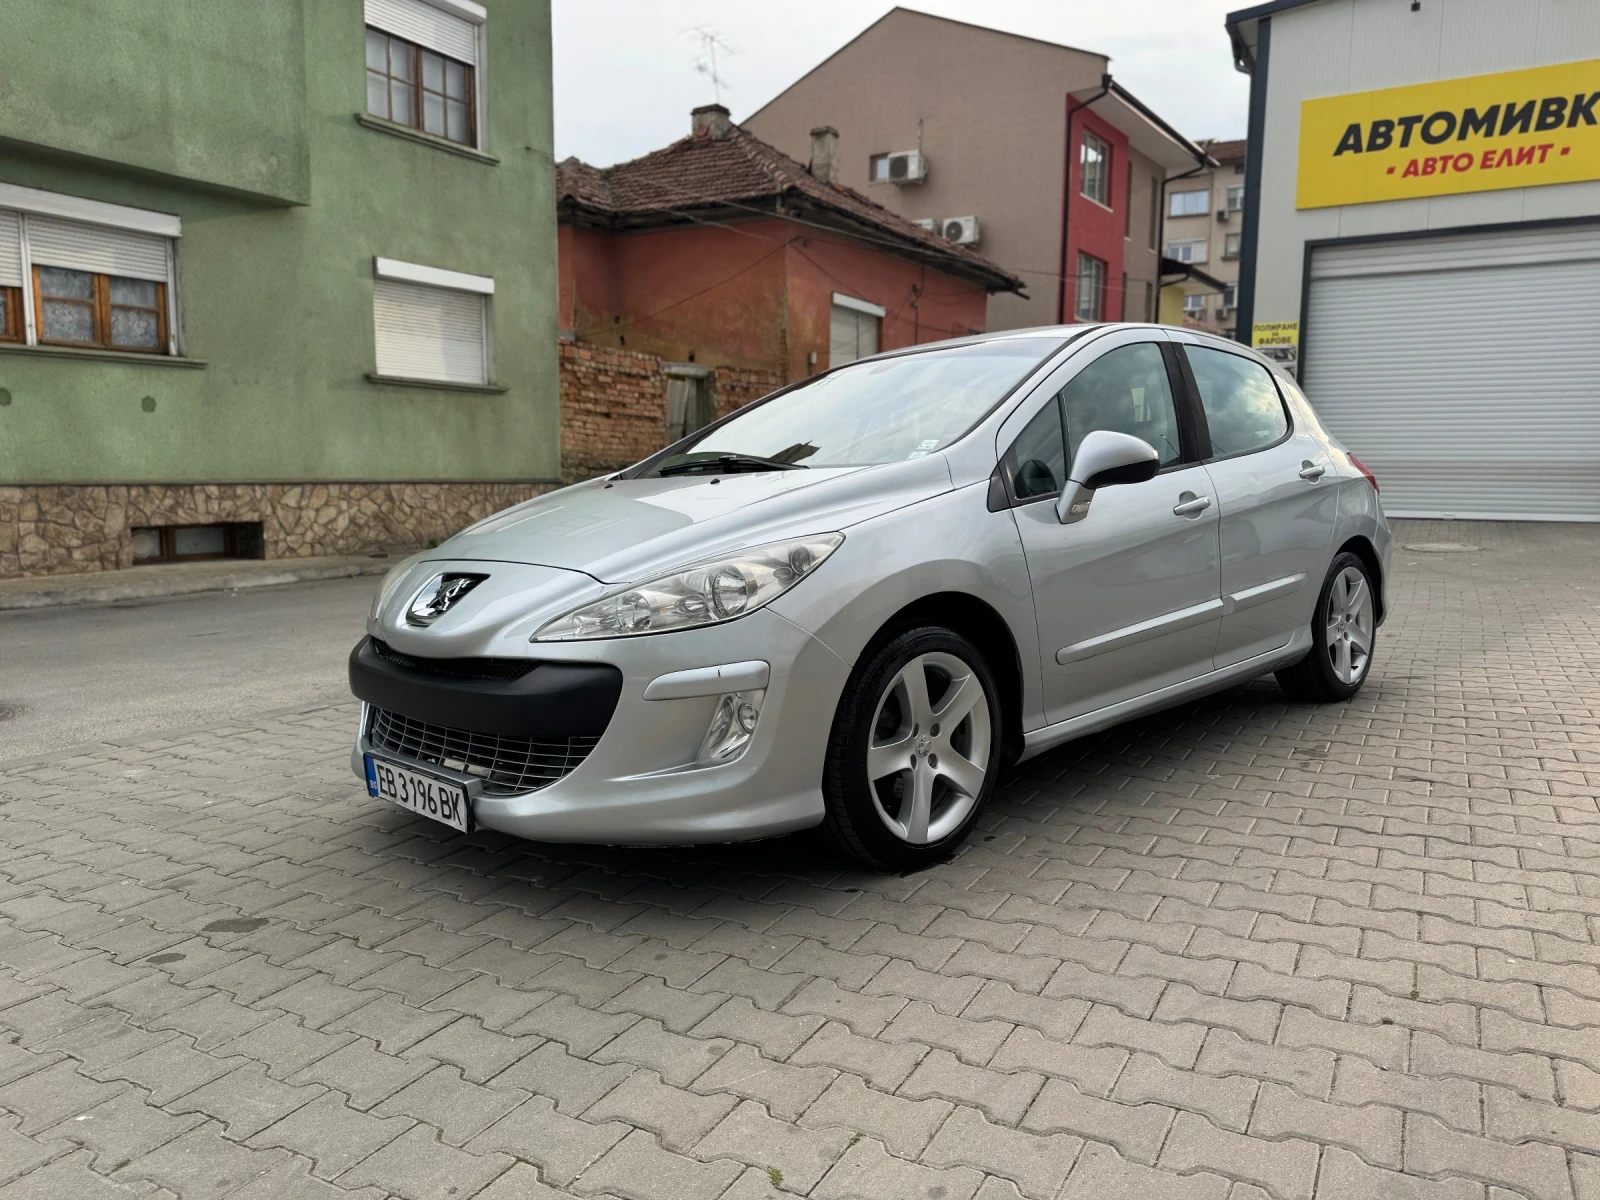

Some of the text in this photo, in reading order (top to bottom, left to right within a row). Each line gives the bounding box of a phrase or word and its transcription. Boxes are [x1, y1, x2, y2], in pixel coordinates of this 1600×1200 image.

[1332, 91, 1600, 157] АВТОМИВК
[1401, 144, 1554, 178] АВТО ЕЛИТ
[1258, 336, 1292, 345] ФАРОВЕ
